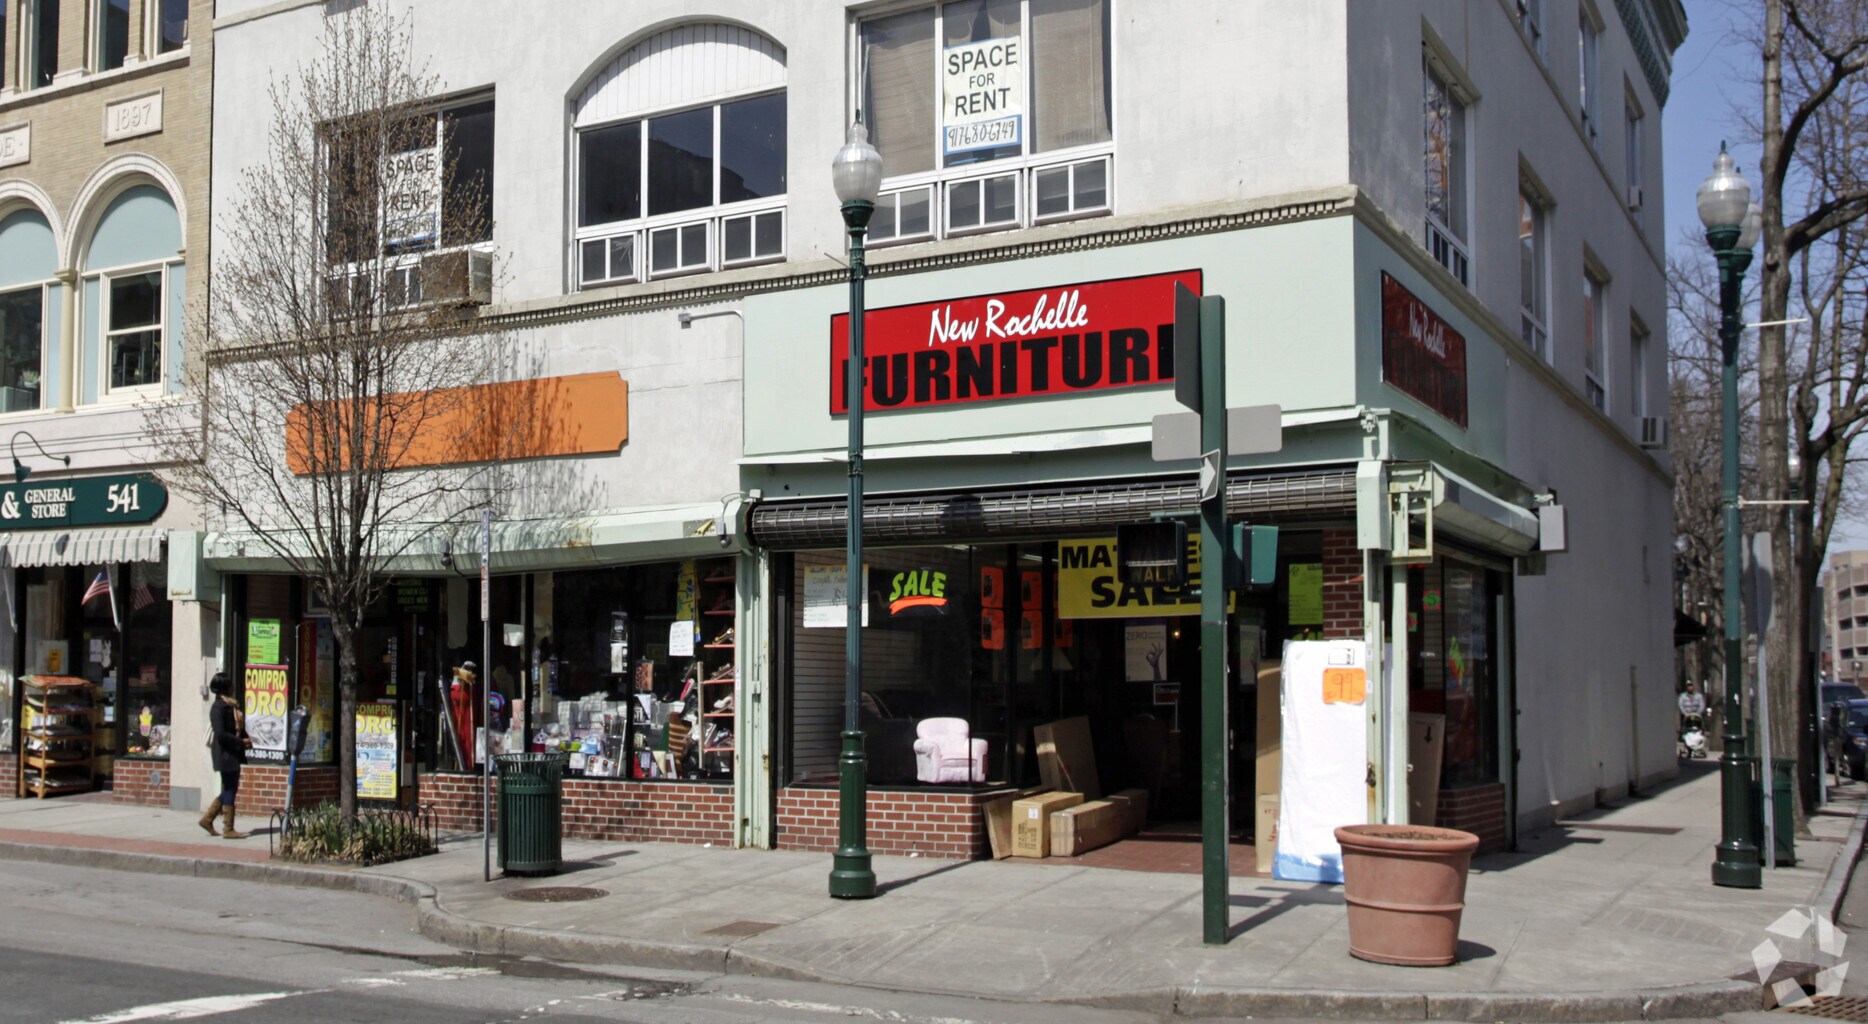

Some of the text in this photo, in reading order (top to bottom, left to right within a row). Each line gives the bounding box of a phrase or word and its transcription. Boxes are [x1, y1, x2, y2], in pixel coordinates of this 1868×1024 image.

[948, 43, 1017, 76] SPACE
[969, 72, 995, 89] FOR
[955, 87, 1011, 117] RENT
[115, 103, 151, 132] 1897
[386, 153, 435, 178] SPACE
[928, 289, 1088, 347] New Rochelle
[1, 483, 140, 519] & GENERAL 541
[31, 503, 67, 519] STORE
[889, 570, 946, 602] SALE
[245, 668, 287, 691] COMPRO
[245, 690, 286, 717] ORO
